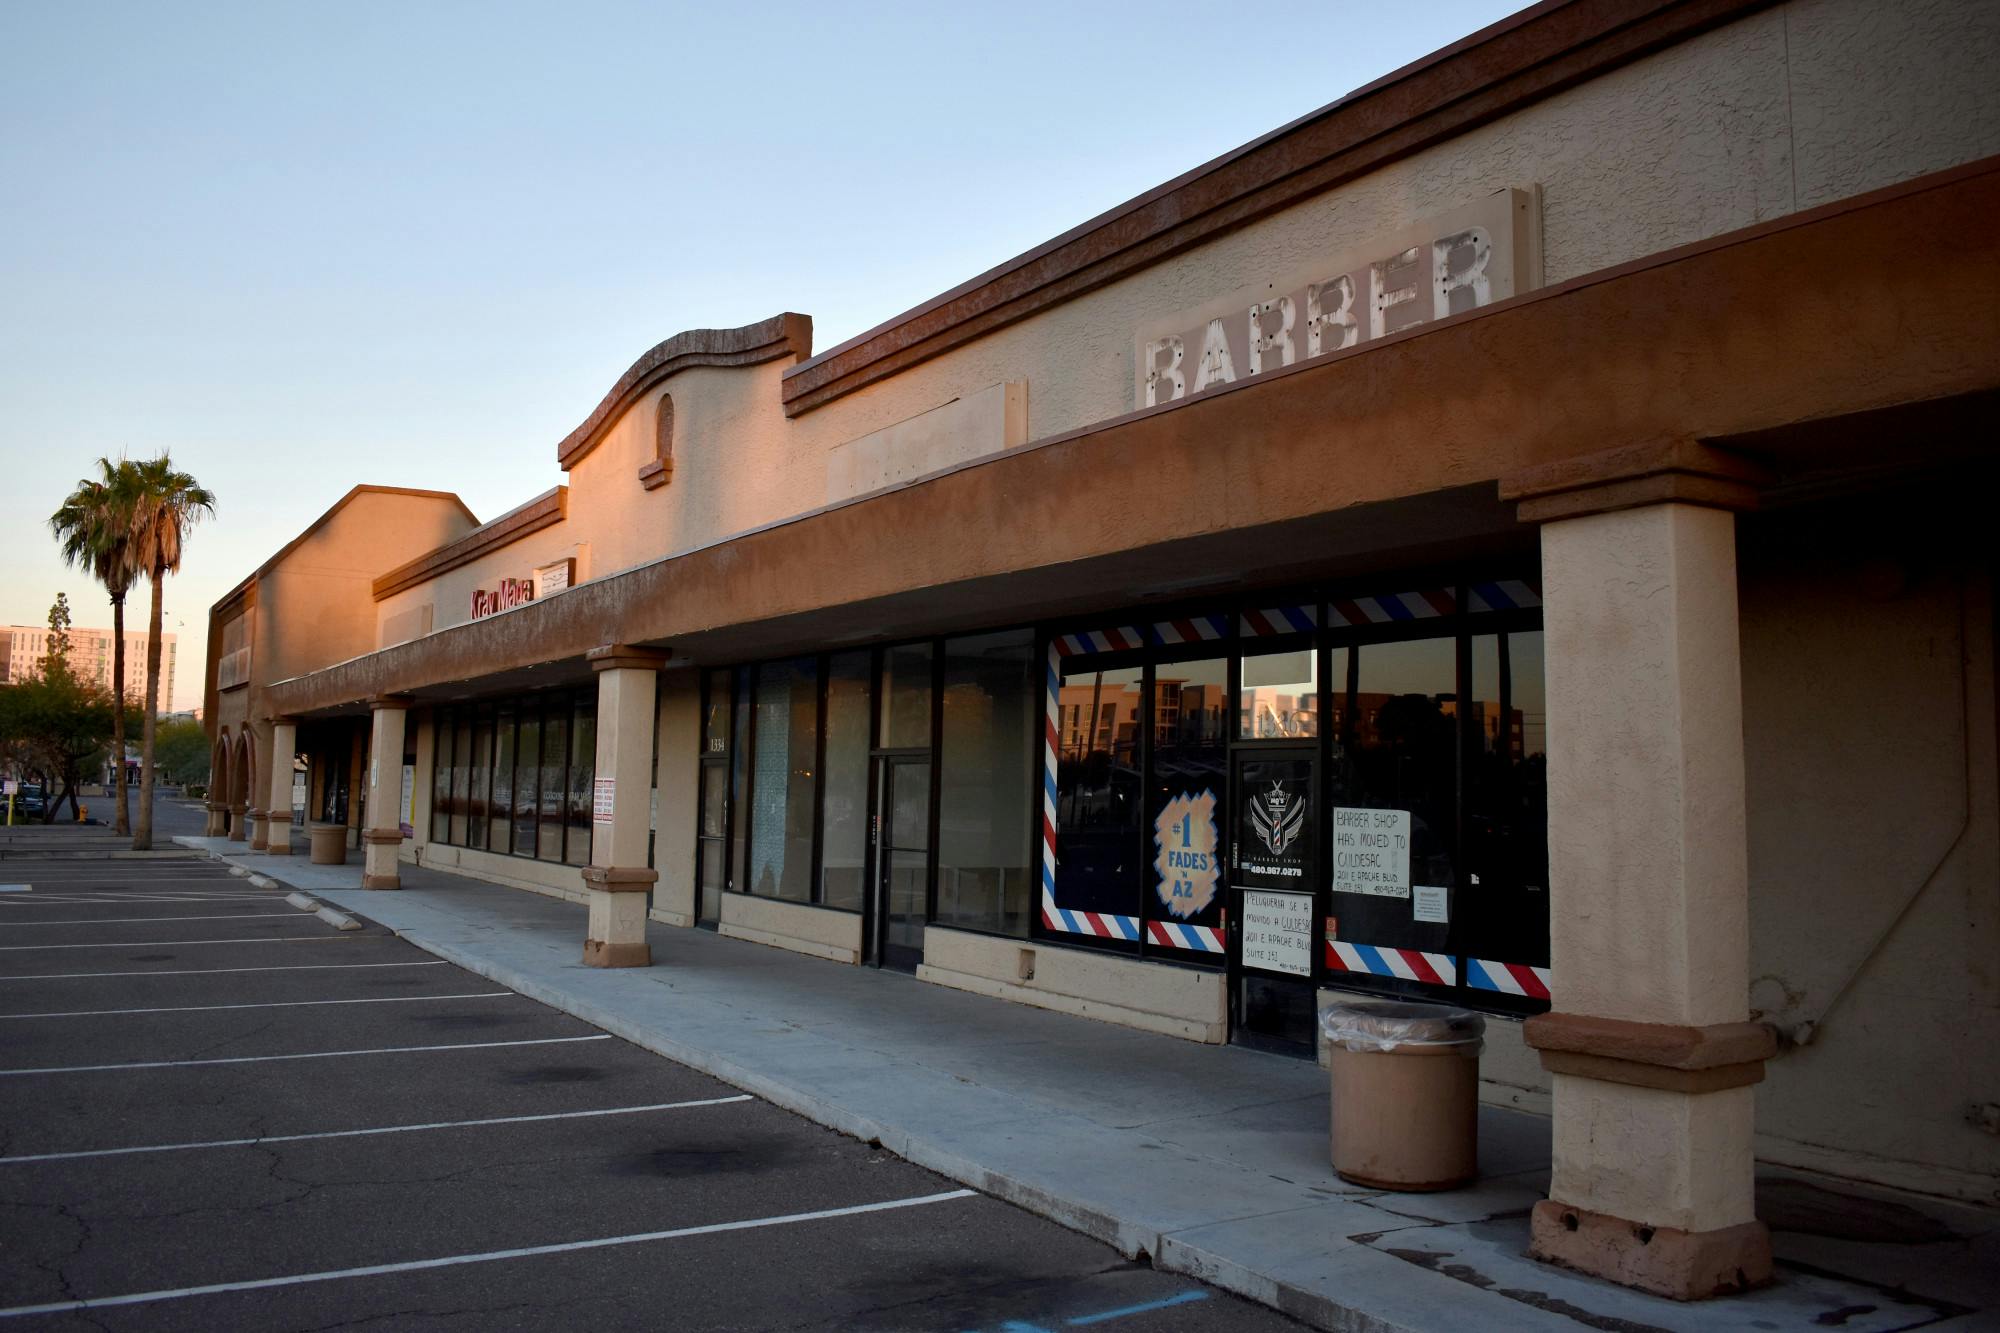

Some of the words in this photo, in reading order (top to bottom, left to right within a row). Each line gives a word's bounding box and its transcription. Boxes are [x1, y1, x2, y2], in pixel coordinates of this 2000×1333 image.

[1145, 226, 1492, 408] BARBER
[471, 590, 498, 619] Krav
[1336, 811, 1369, 828] BARBER
[1374, 813, 1399, 829] SHOP
[1172, 813, 1191, 847] #1
[1337, 832, 1355, 847] HAS
[1360, 833, 1390, 848] MOVED
[1394, 834, 1406, 849] TO
[1168, 850, 1208, 871] FADES
[1337, 851, 1382, 868] CULDESAC
[1357, 872, 1382, 882] APACHE
[1172, 881, 1193, 898] AZ
[1289, 900, 1297, 912] SE
[1303, 902, 1309, 913] A
[1246, 913, 1271, 926] MOVIDO
[1274, 917, 1279, 926] A
[1260, 933, 1265, 944] E
[1246, 948, 1265, 960] SUITE
